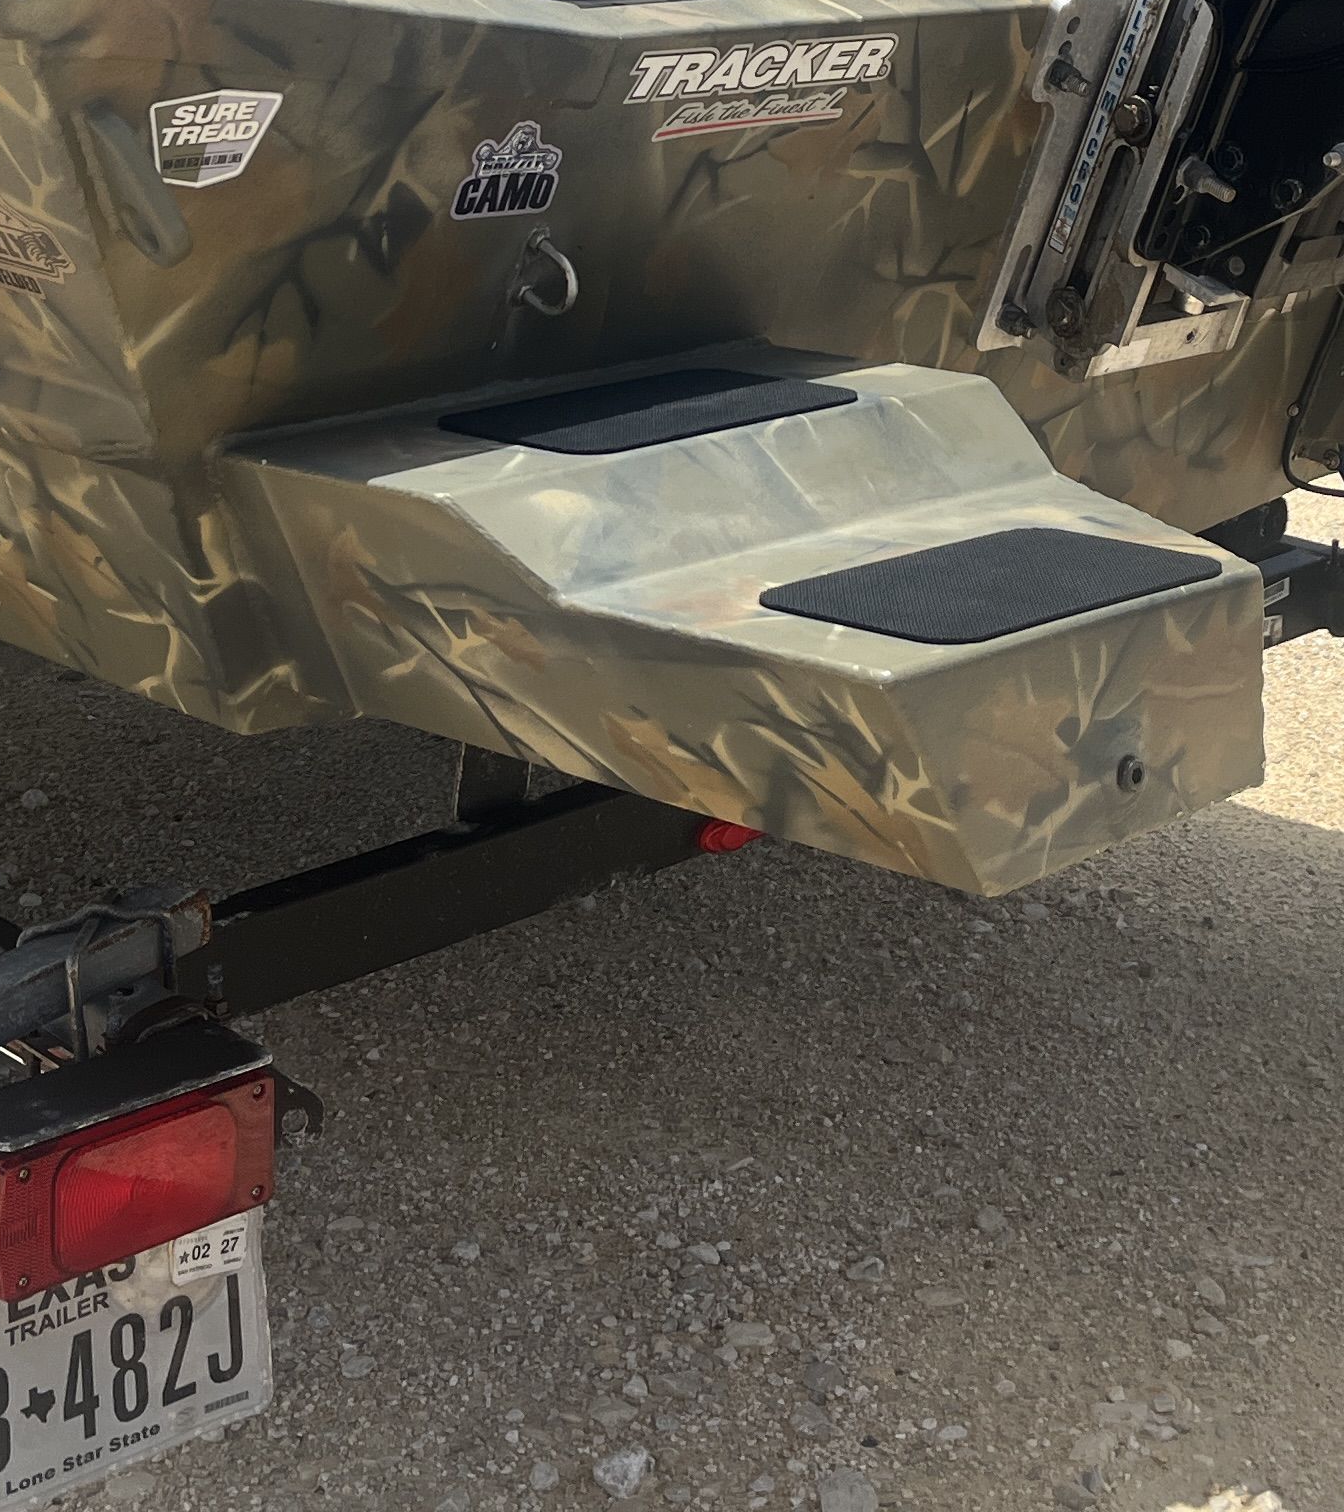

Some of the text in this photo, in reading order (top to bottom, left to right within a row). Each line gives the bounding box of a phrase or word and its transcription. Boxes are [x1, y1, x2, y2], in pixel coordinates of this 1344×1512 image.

[633, 37, 895, 101] TRACKER
[161, 120, 260, 147] TREAD
[171, 100, 258, 126] SURE
[667, 105, 714, 127] Fish
[719, 103, 751, 121] the
[1069, 90, 1117, 203] MICRO
[454, 172, 555, 215] CAMO
[191, 1242, 211, 1261] 02
[220, 1236, 240, 1254] 27
[4, 1291, 110, 1347] TRAILER
[63, 1273, 244, 1441] 482J
[5, 1464, 56, 1496] Lone
[62, 1446, 103, 1473] Star
[108, 1422, 161, 1454] State
